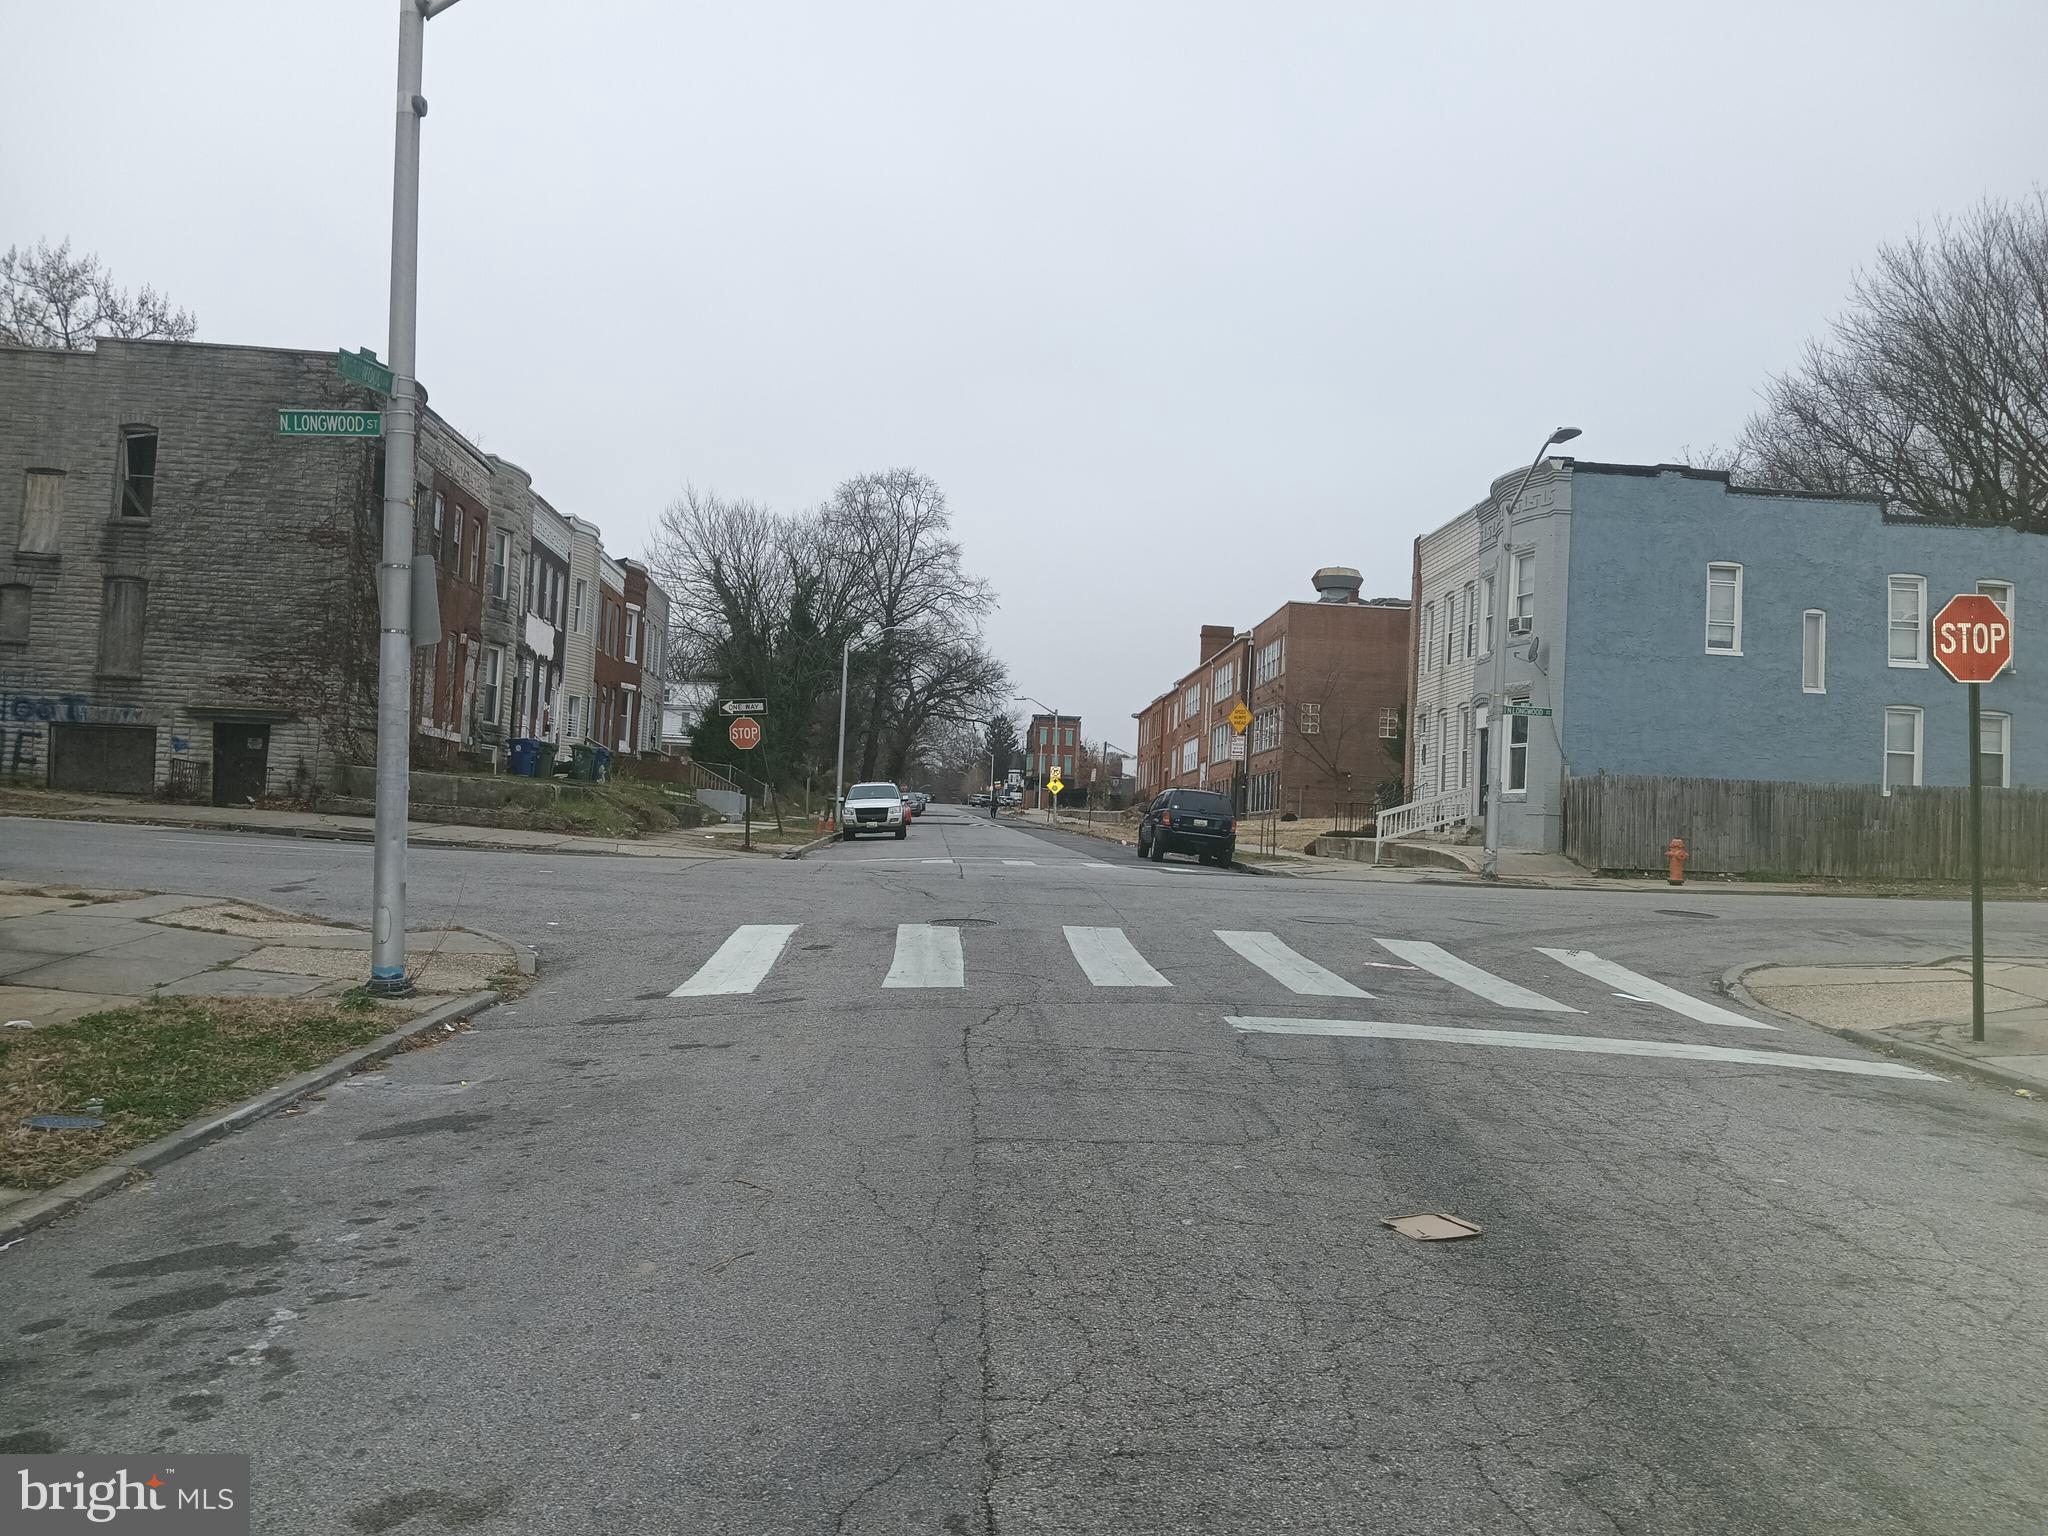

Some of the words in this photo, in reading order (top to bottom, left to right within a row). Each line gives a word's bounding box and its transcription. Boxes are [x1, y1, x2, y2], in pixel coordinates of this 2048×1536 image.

[280, 415, 291, 431] N.
[294, 415, 365, 432] LONGWOOD
[366, 419, 379, 429] ST
[1940, 622, 2006, 654] STOP
[1512, 707, 1543, 715] LONGWOOD
[732, 727, 758, 740] STOP
